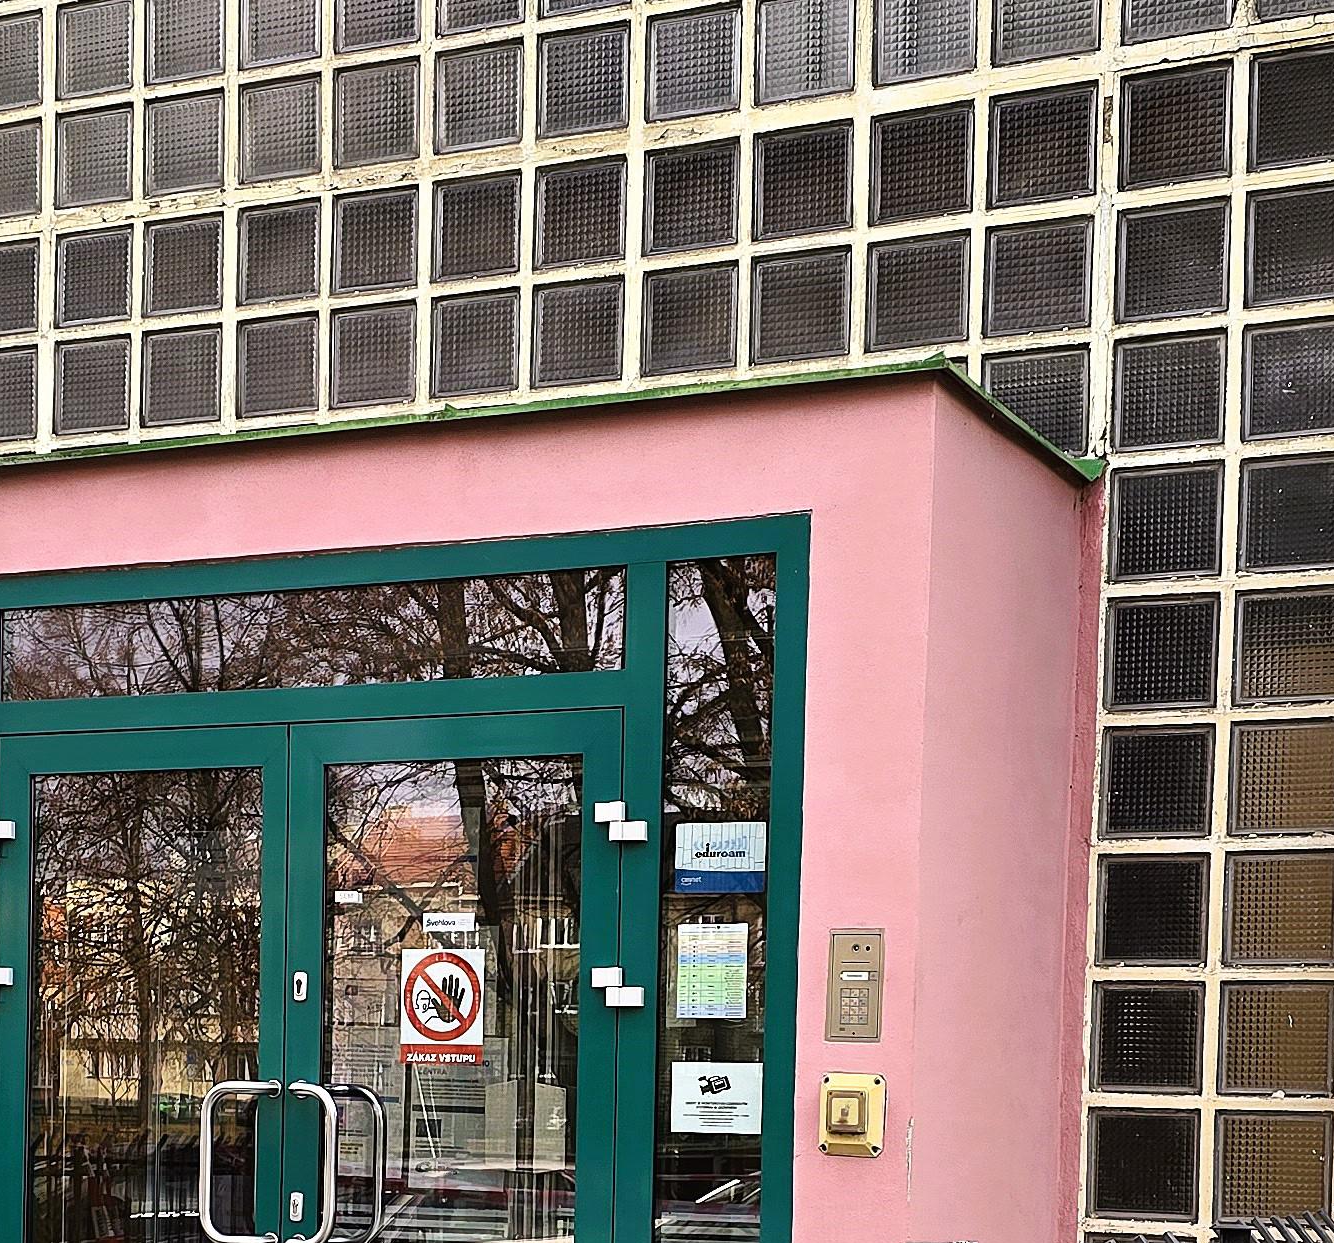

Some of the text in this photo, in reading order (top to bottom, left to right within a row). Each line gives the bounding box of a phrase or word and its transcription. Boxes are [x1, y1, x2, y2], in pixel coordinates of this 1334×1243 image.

[695, 842, 746, 858] eduroam
[407, 1051, 476, 1063] ZÁKAZ VSTUPU
